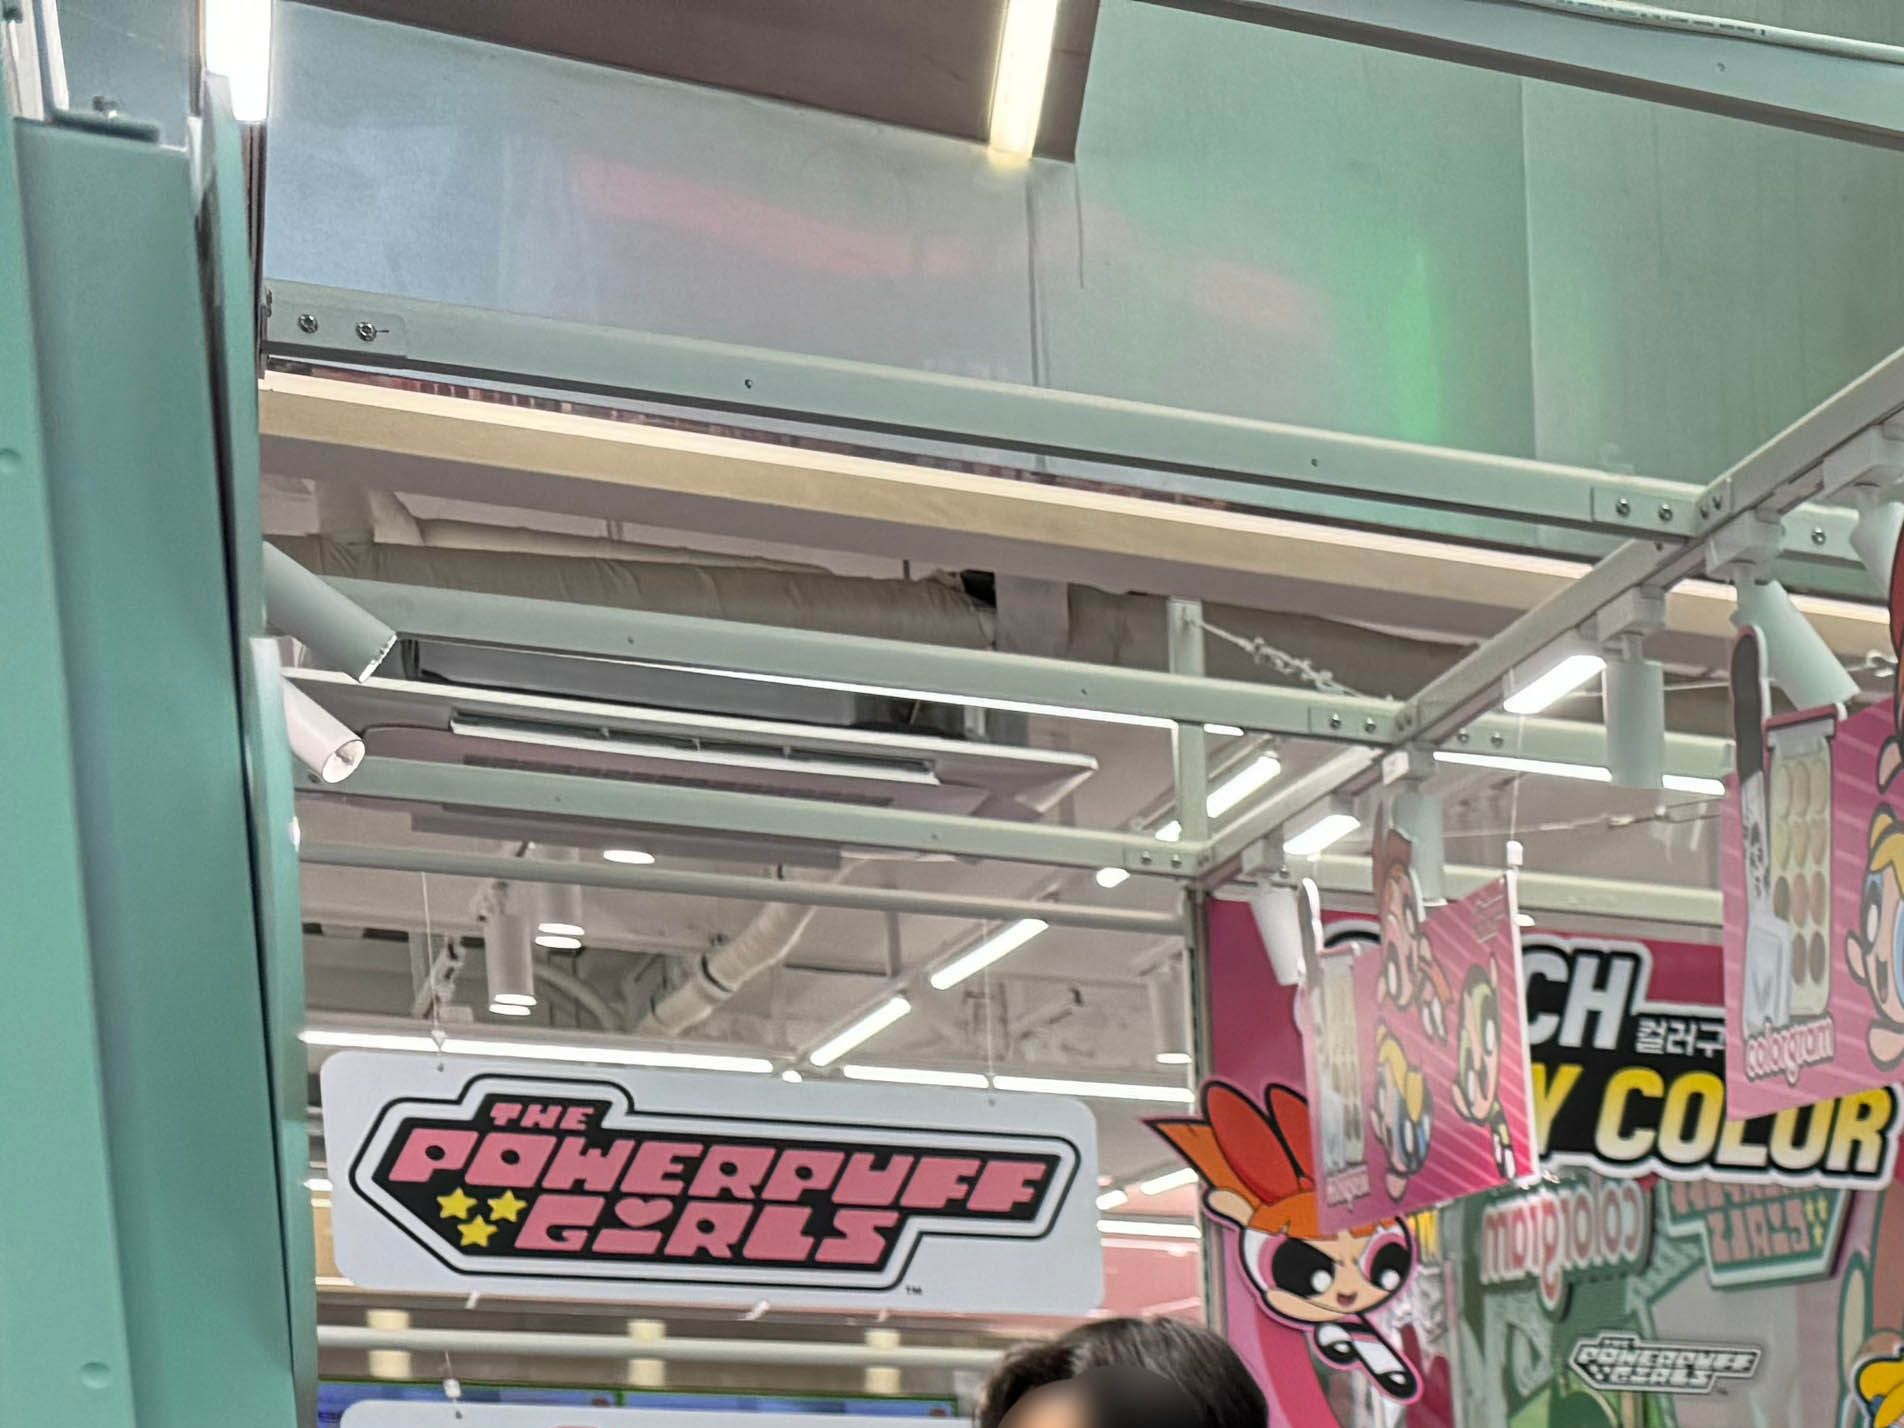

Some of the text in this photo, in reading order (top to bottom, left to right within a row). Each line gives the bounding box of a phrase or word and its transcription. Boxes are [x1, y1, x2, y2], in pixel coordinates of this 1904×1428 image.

[1636, 1016, 1725, 1058] 컬러구
[488, 1101, 595, 1132] THE
[1595, 1066, 1892, 1173] COLOR
[388, 1129, 1049, 1213] POWERPUFF
[515, 1195, 901, 1267] GIRLS
